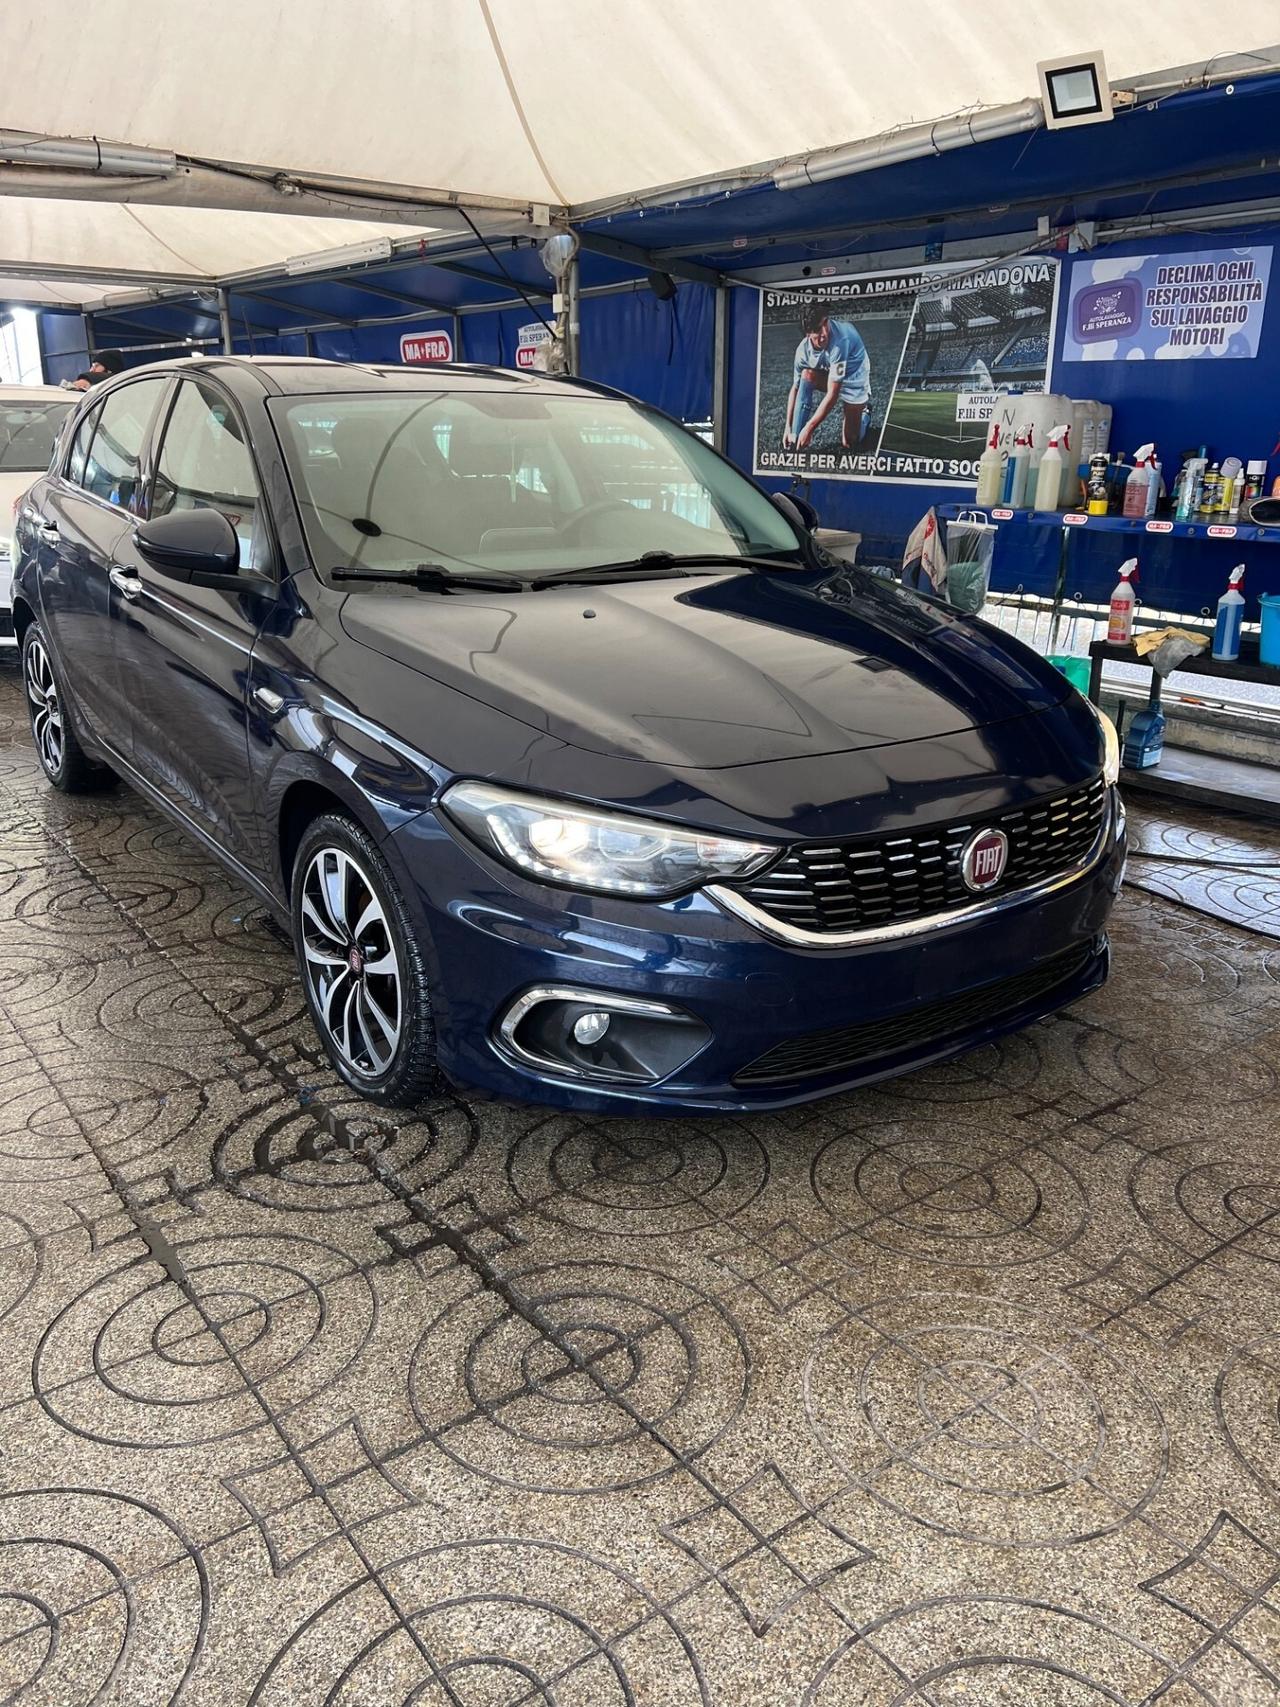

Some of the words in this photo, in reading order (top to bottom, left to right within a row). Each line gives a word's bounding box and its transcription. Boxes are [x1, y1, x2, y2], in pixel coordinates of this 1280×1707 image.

[818, 284, 861, 302] DIEGO
[947, 264, 1050, 291] MARADONA
[1157, 264, 1214, 285] DECLINA
[1217, 261, 1254, 281] OGNI
[1146, 279, 1262, 306] RESPONSABILITÀ
[1096, 317, 1132, 329] SPERANZA
[1151, 307, 1176, 326] SUL
[1178, 305, 1248, 325] LAVAGGIO
[1169, 327, 1225, 346] MOTORI
[760, 452, 806, 467] GRAZIE
[810, 454, 836, 469] PER
[839, 455, 891, 472] AVERCI
[896, 457, 944, 474] FATTO
[975, 845, 1001, 877] FIAT
